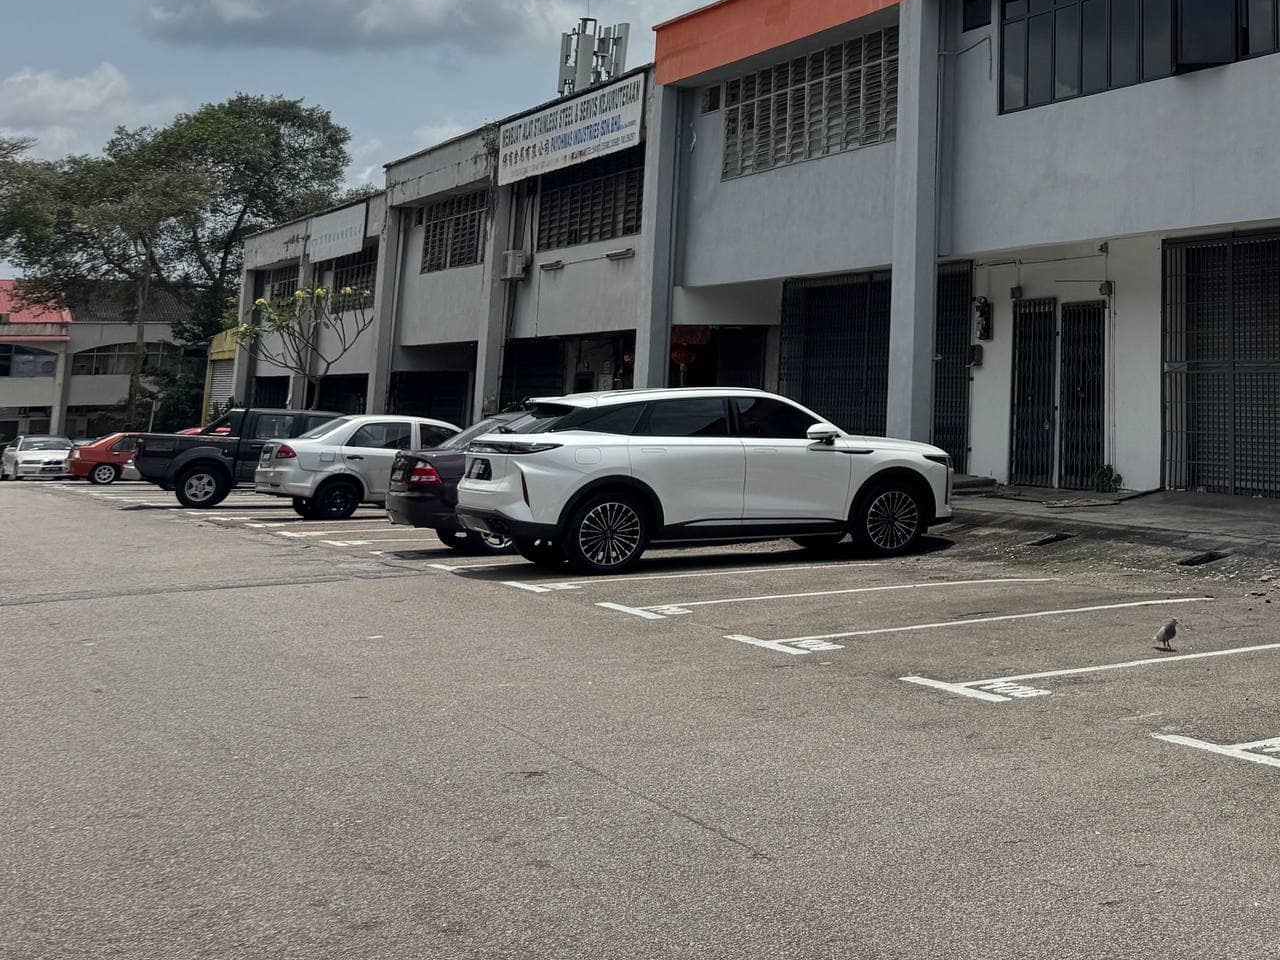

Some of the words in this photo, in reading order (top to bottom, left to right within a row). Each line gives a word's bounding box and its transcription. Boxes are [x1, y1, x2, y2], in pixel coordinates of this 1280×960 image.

[536, 110, 558, 136] STAINLESS
[559, 105, 574, 128] STEEL
[580, 96, 598, 121] SERVIS
